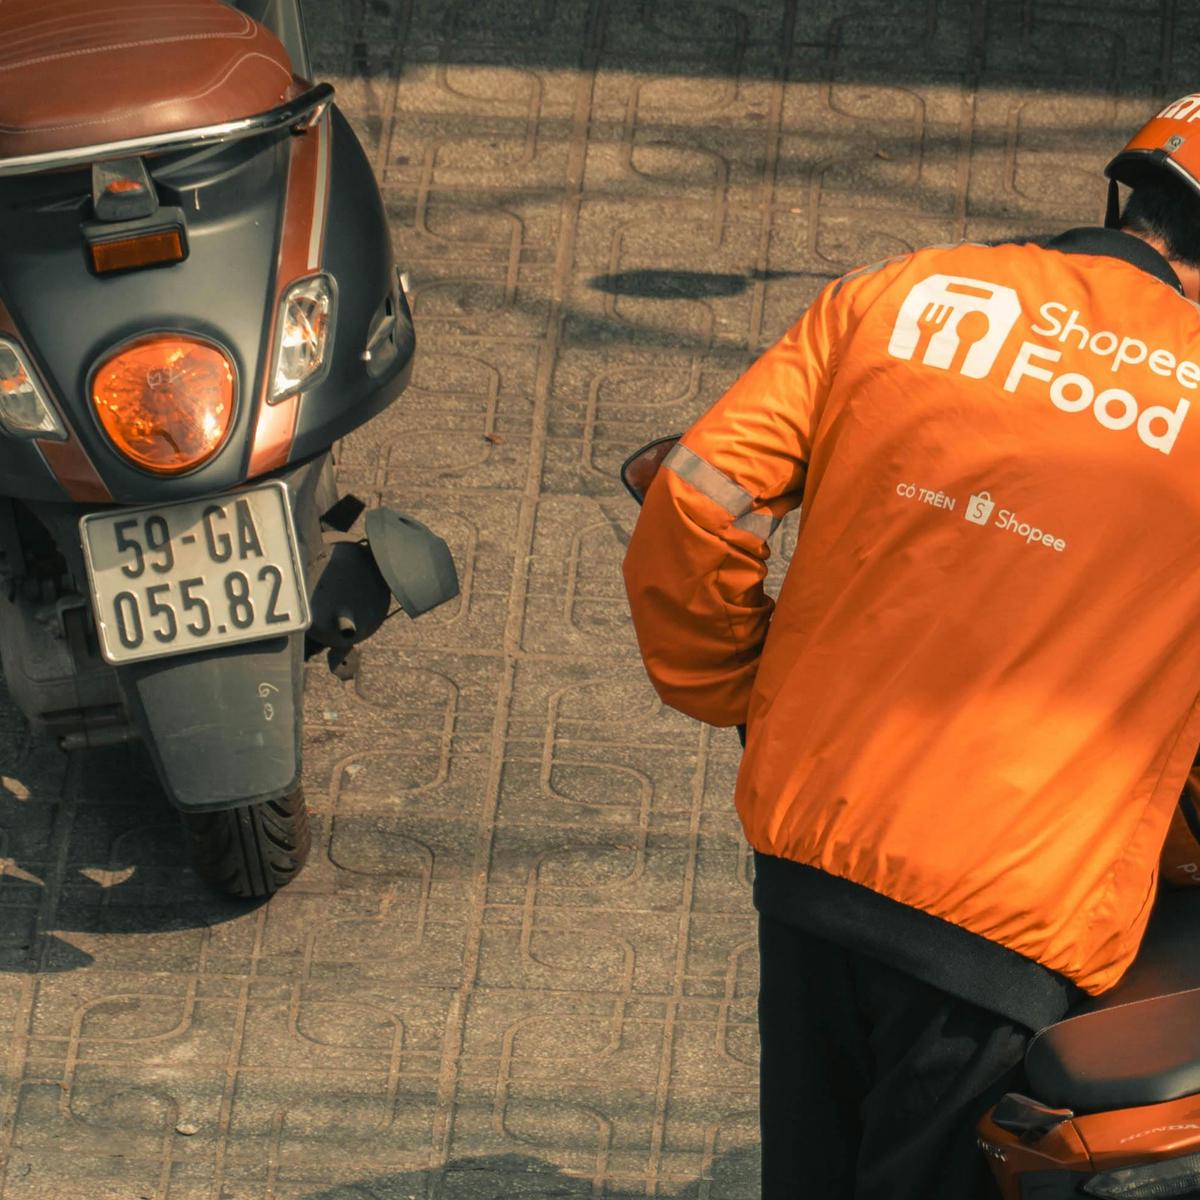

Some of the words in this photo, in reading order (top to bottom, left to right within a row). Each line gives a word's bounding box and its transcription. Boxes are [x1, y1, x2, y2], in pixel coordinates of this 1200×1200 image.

[1003, 341, 1191, 456] Food
[113, 498, 265, 579] 59-GA
[896, 480, 917, 499] CÓ
[917, 484, 956, 512] TRÊN
[994, 507, 1067, 553] Shopee
[113, 564, 291, 650] 055.82
